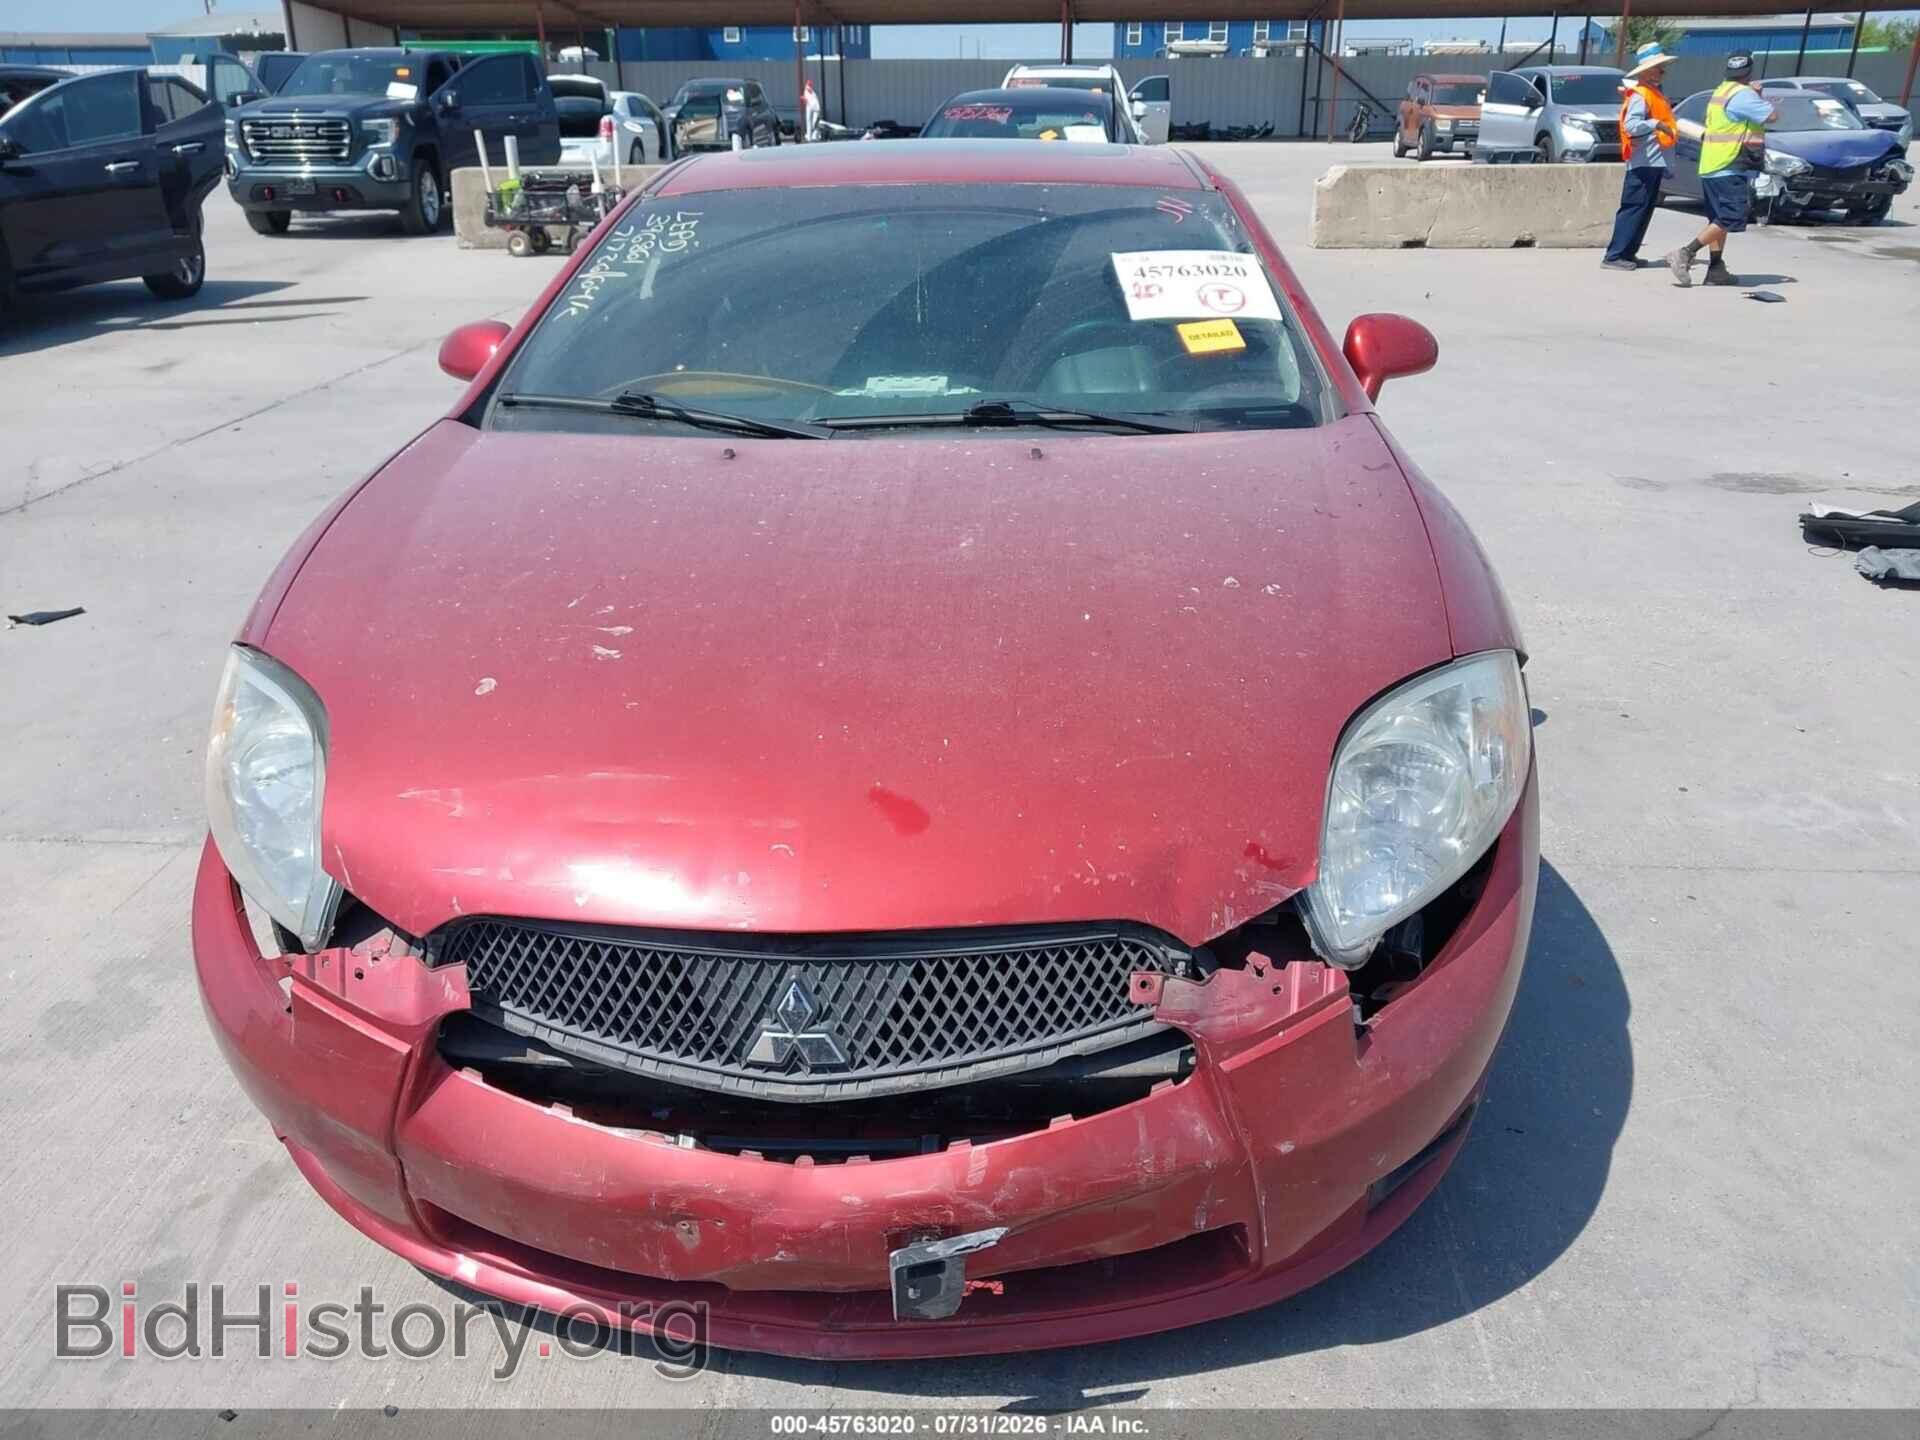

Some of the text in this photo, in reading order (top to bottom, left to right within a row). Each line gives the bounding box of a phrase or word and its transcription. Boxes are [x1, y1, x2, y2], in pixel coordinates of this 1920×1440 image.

[271, 126, 316, 138] GMC
[1133, 264, 1248, 279] 45763020
[1187, 329, 1234, 341] DETAILED
